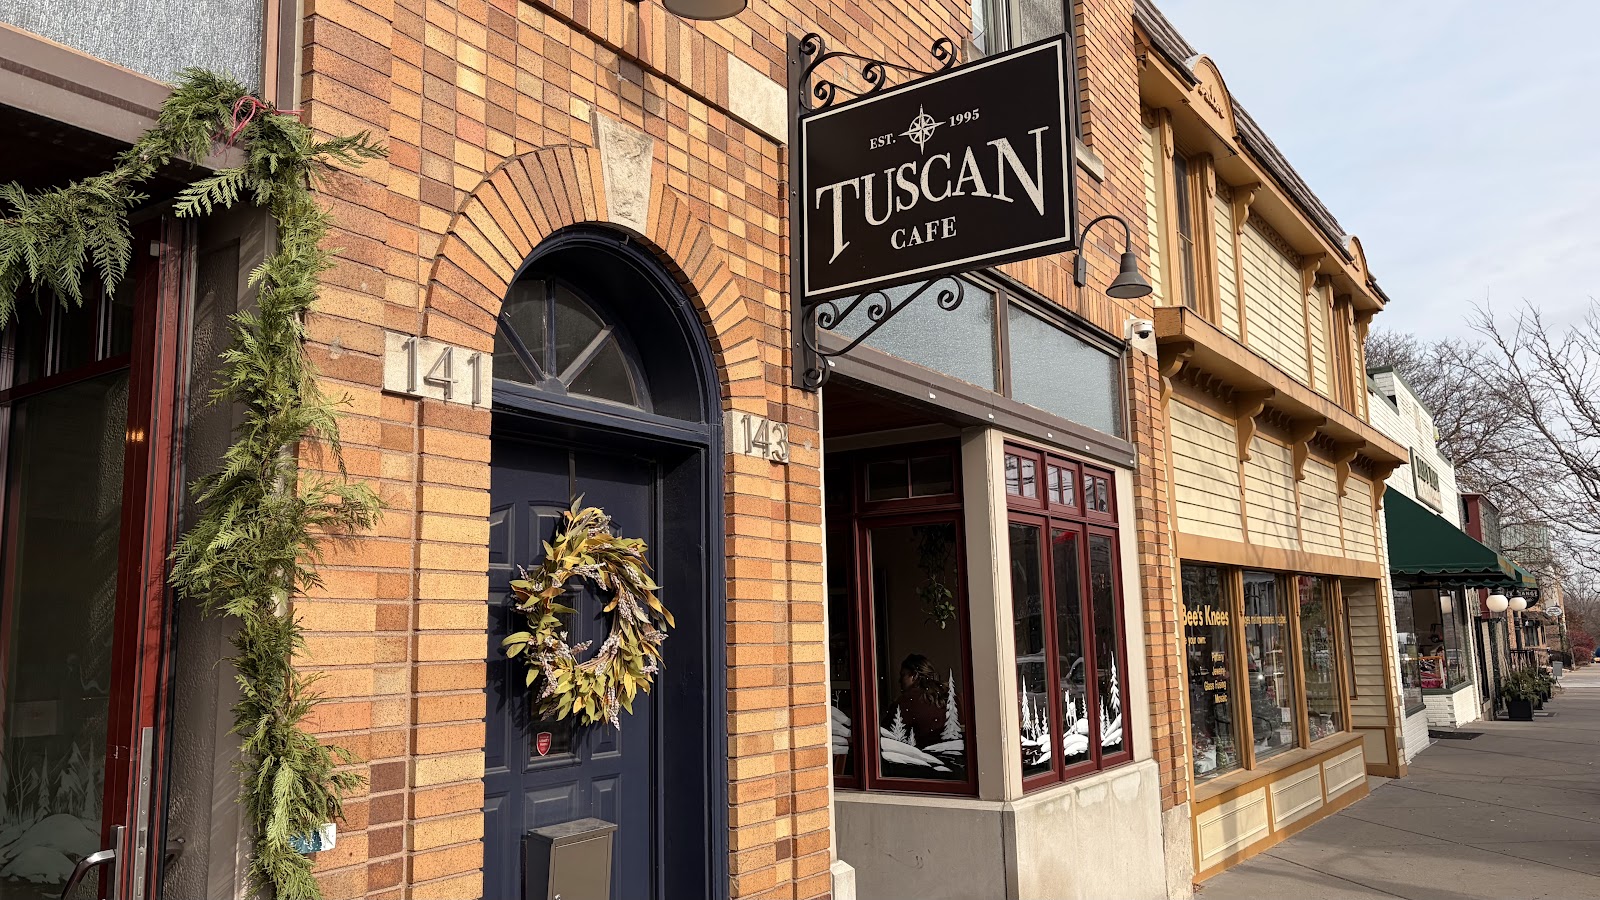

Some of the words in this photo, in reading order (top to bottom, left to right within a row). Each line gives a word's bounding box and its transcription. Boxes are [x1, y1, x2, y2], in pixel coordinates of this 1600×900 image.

[869, 133, 896, 150] EST.
[949, 108, 980, 127] 1995
[815, 125, 1049, 264] TUSCAN
[890, 216, 957, 250] CAFE
[402, 337, 481, 404] 141
[741, 414, 788, 460] 143
[1182, 604, 1204, 626] Bee's
[1204, 605, 1229, 626] Knees
[1204, 681, 1214, 690] Glass
[1215, 680, 1226, 690] Fusing
[1214, 693, 1227, 703] Mosaic
